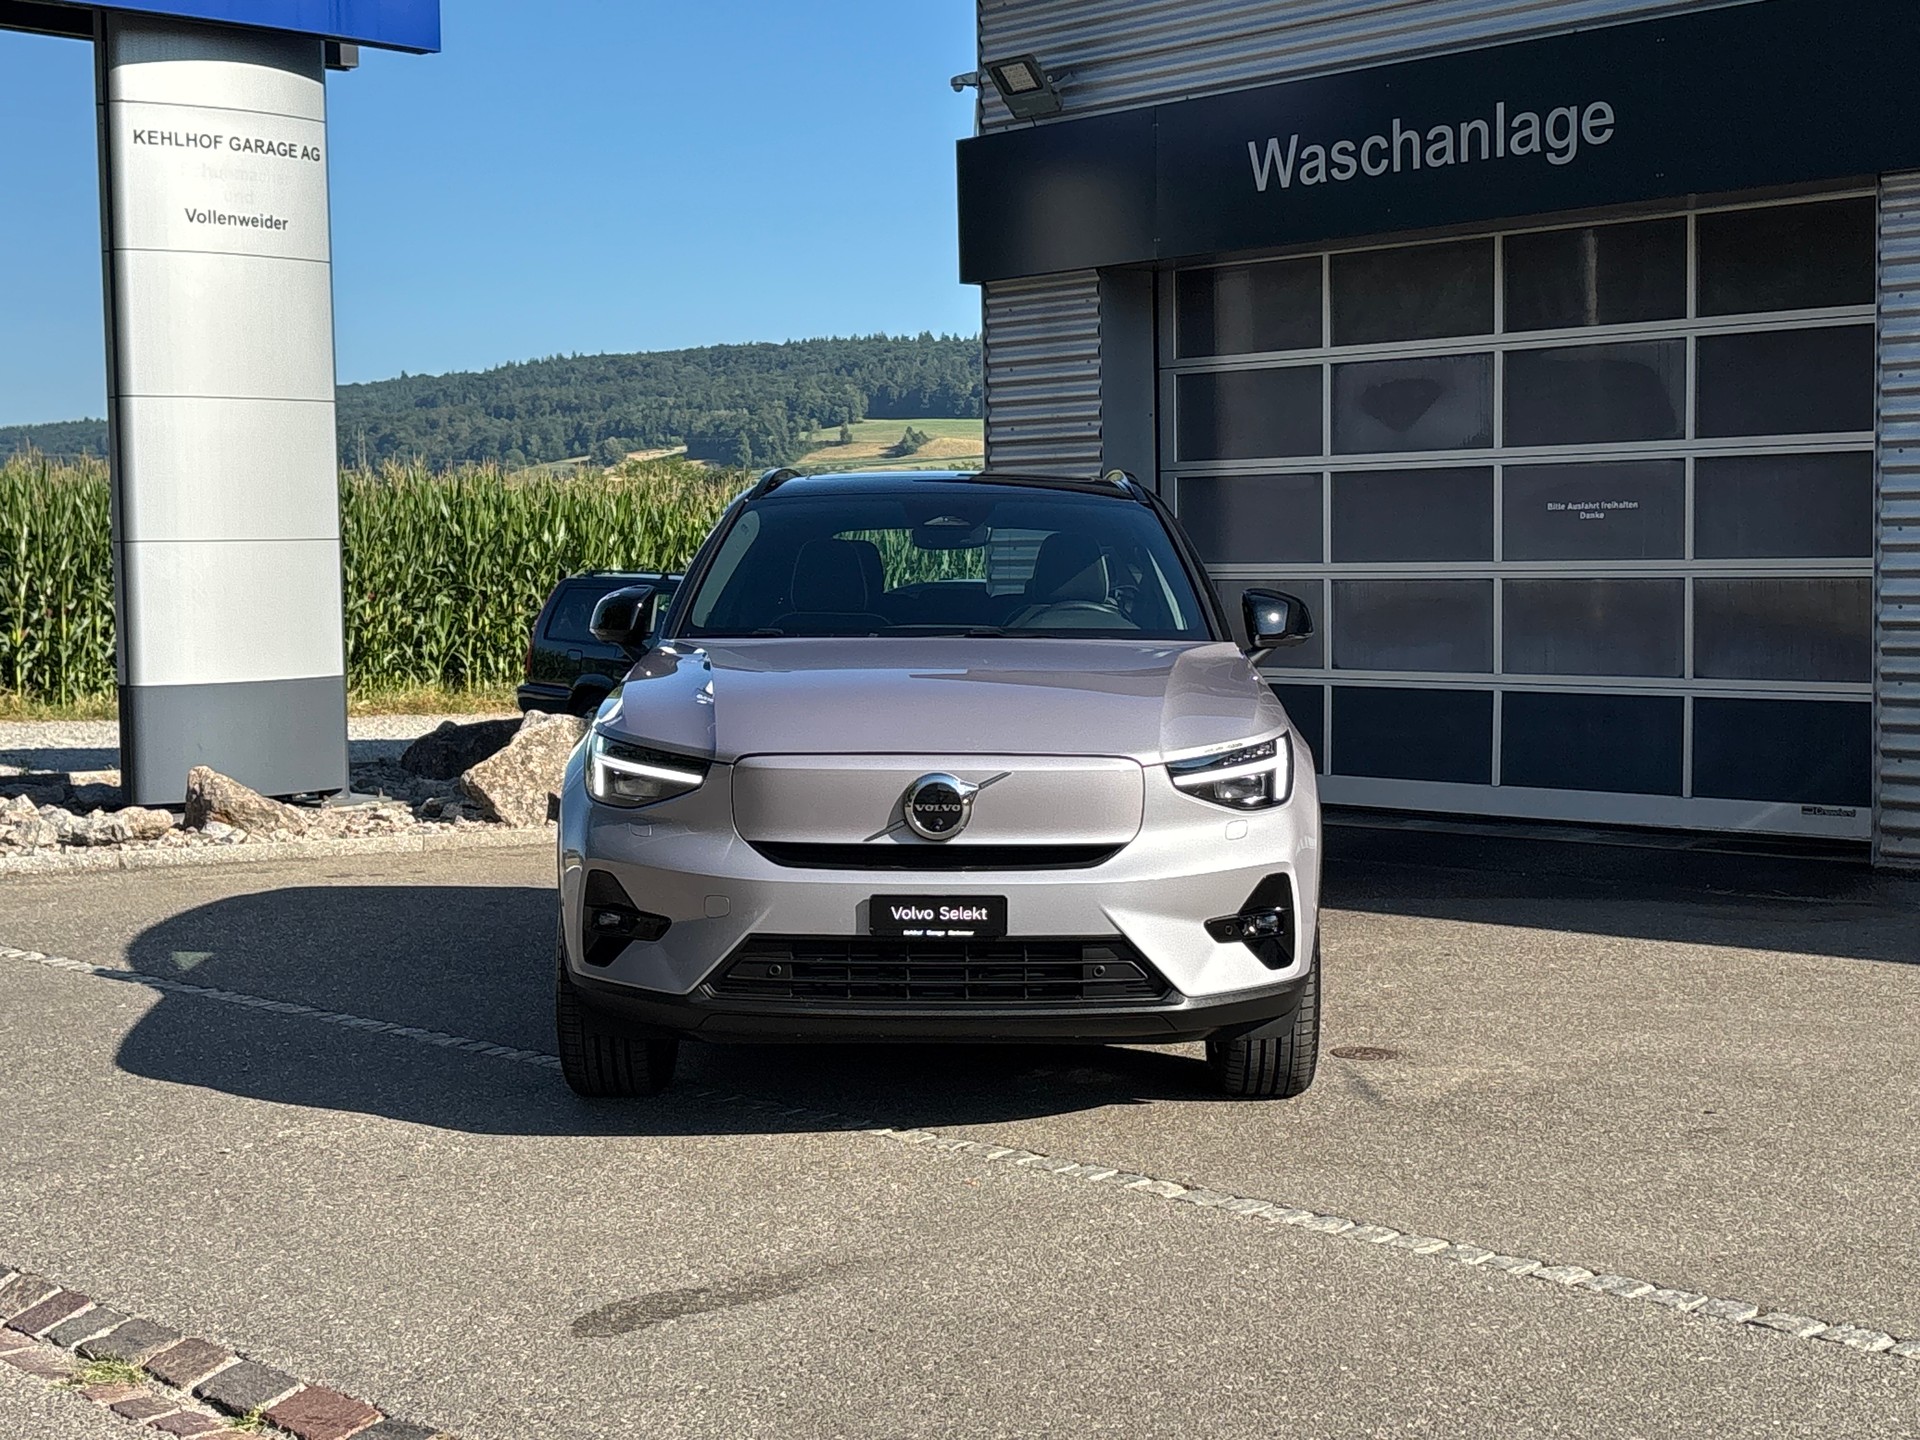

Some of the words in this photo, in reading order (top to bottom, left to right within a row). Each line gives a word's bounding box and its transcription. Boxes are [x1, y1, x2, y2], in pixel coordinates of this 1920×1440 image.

[133, 128, 224, 150] KEHLHOF
[229, 136, 298, 159] GARAGE
[301, 145, 322, 162] AG
[1247, 99, 1616, 193] Waschanlage
[184, 207, 289, 231] Vollenweider
[1547, 502, 1566, 511] Bitte
[1567, 501, 1600, 510] Ausfahrt
[1579, 511, 1605, 520] Danke
[914, 803, 961, 813] VOLVO
[890, 905, 935, 921] Volvo
[939, 905, 988, 921] Selekt
